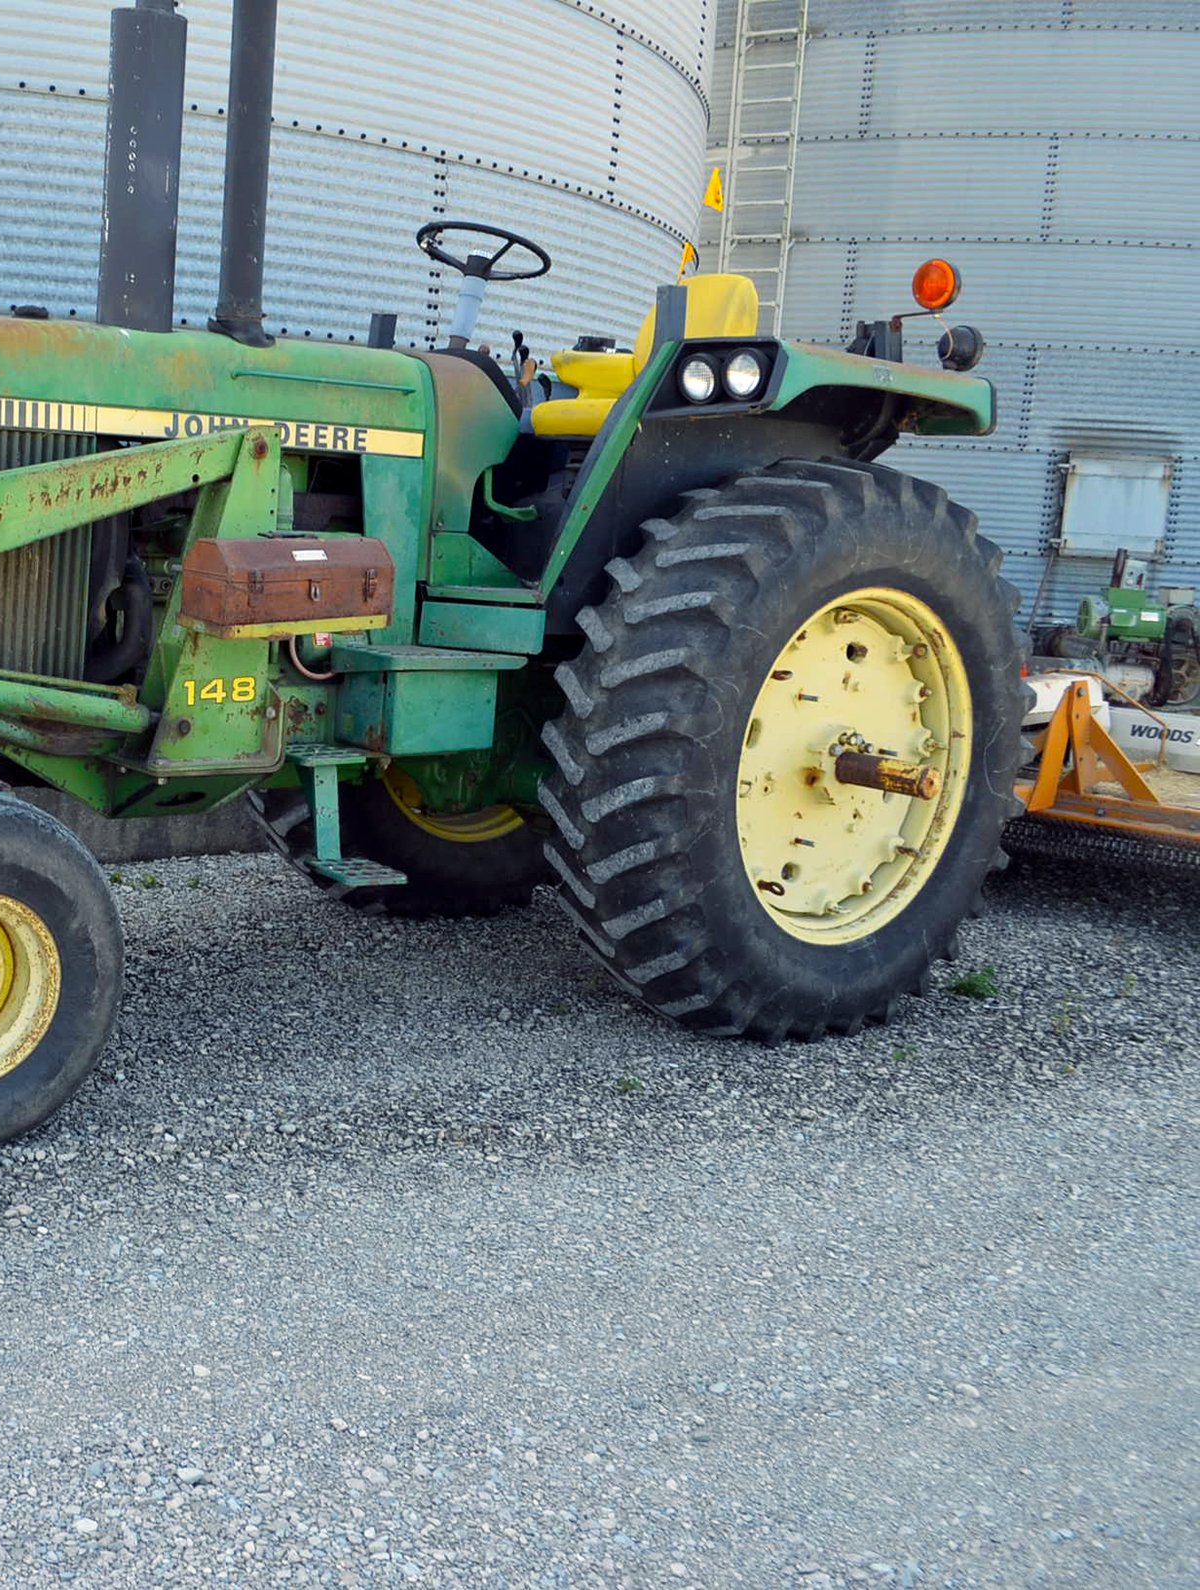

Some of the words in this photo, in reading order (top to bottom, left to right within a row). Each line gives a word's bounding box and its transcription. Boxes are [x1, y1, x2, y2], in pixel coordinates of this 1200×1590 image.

[274, 421, 368, 451] DEERE
[183, 676, 256, 706] 148
[1130, 724, 1195, 744] WOODS
